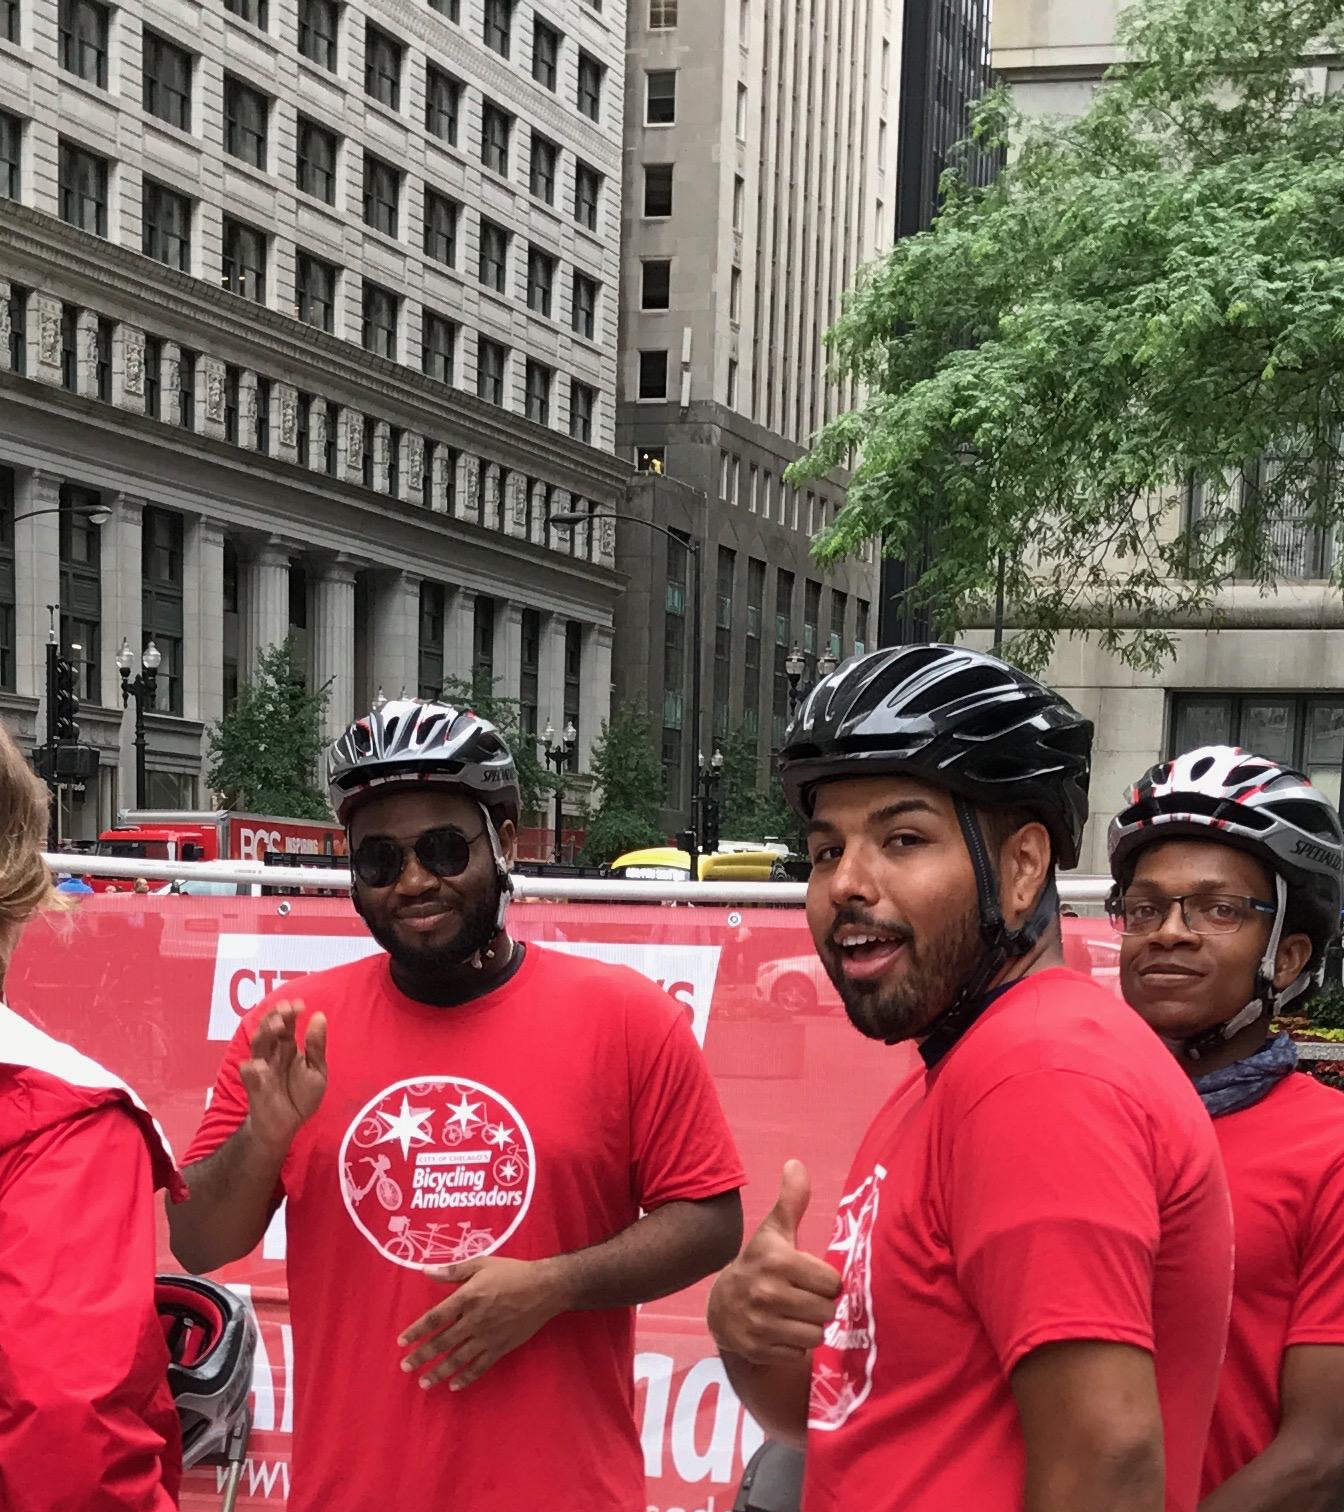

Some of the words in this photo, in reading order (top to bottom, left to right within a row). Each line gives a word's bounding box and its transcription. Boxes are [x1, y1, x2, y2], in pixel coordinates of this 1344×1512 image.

[419, 1156, 435, 1164] CITY
[412, 1165, 485, 1192] Bicycling
[410, 1185, 523, 1209] Ambassadors
